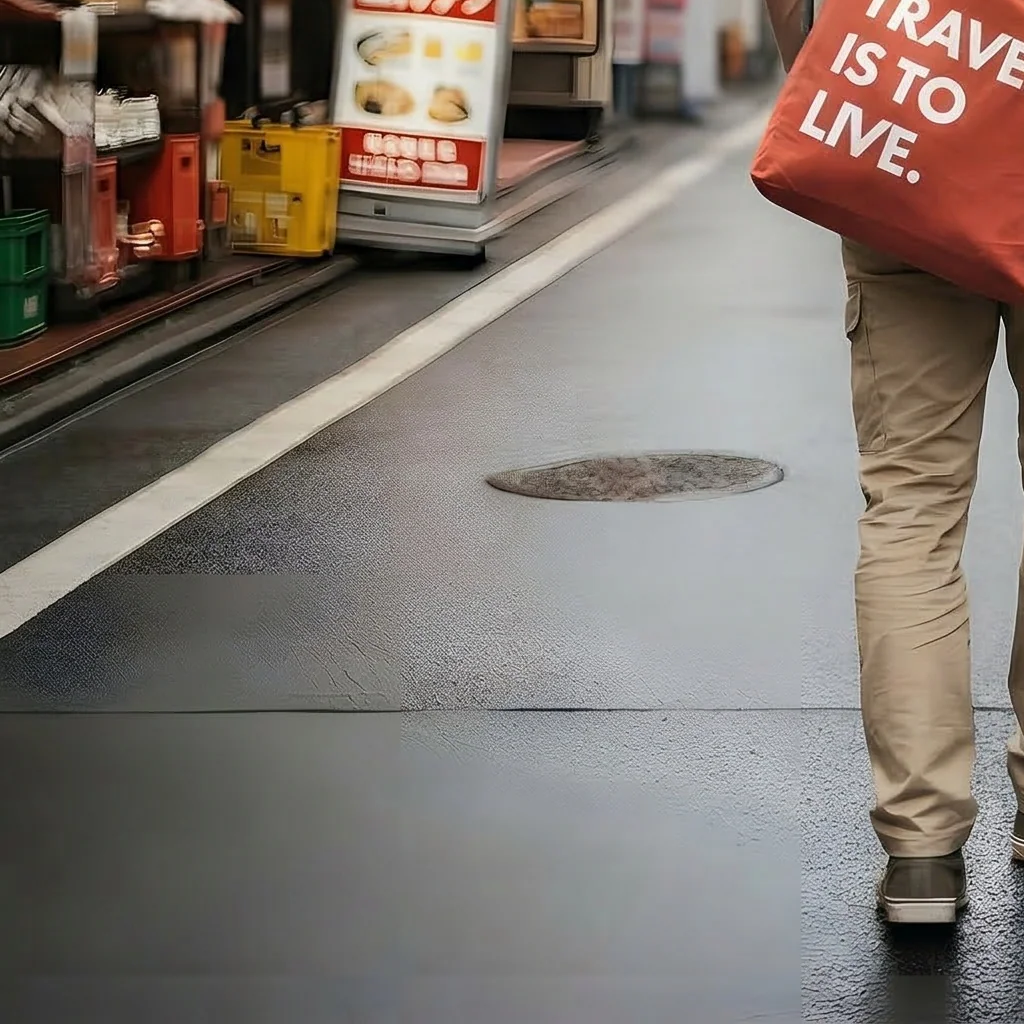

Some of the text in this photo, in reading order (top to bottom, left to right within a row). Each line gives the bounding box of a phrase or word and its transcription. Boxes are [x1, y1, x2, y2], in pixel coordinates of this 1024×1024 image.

[829, 32, 967, 125] IS TO
[798, 89, 921, 185] LIVE.
